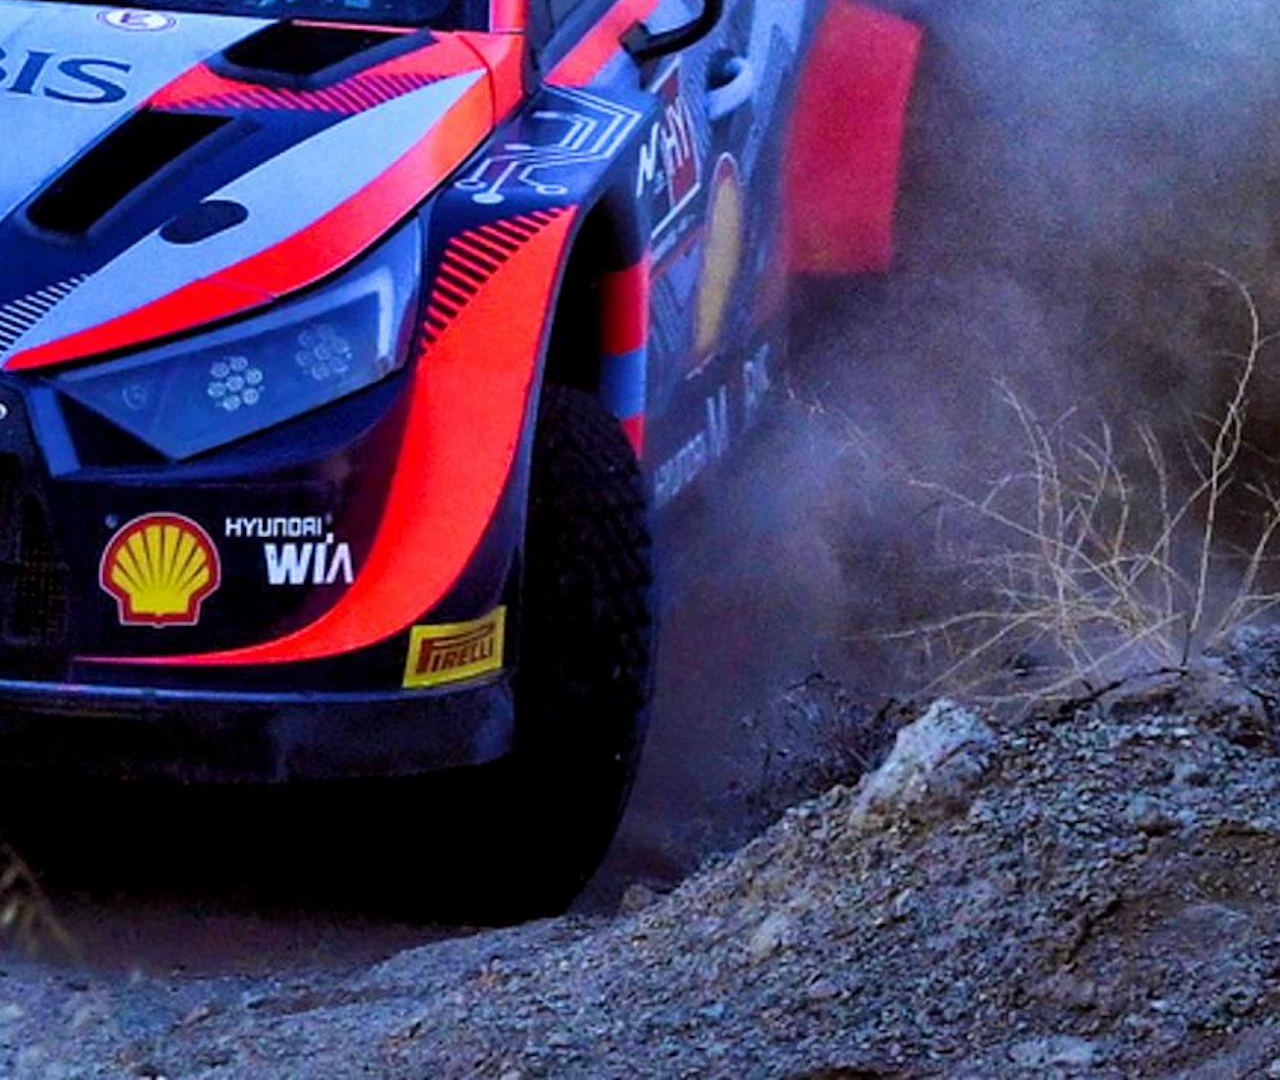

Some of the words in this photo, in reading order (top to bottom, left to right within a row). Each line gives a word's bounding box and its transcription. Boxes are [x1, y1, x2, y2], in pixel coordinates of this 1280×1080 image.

[225, 516, 321, 538] HYUNDAI
[264, 532, 354, 585] WIA
[416, 623, 494, 674] PIRELLI
